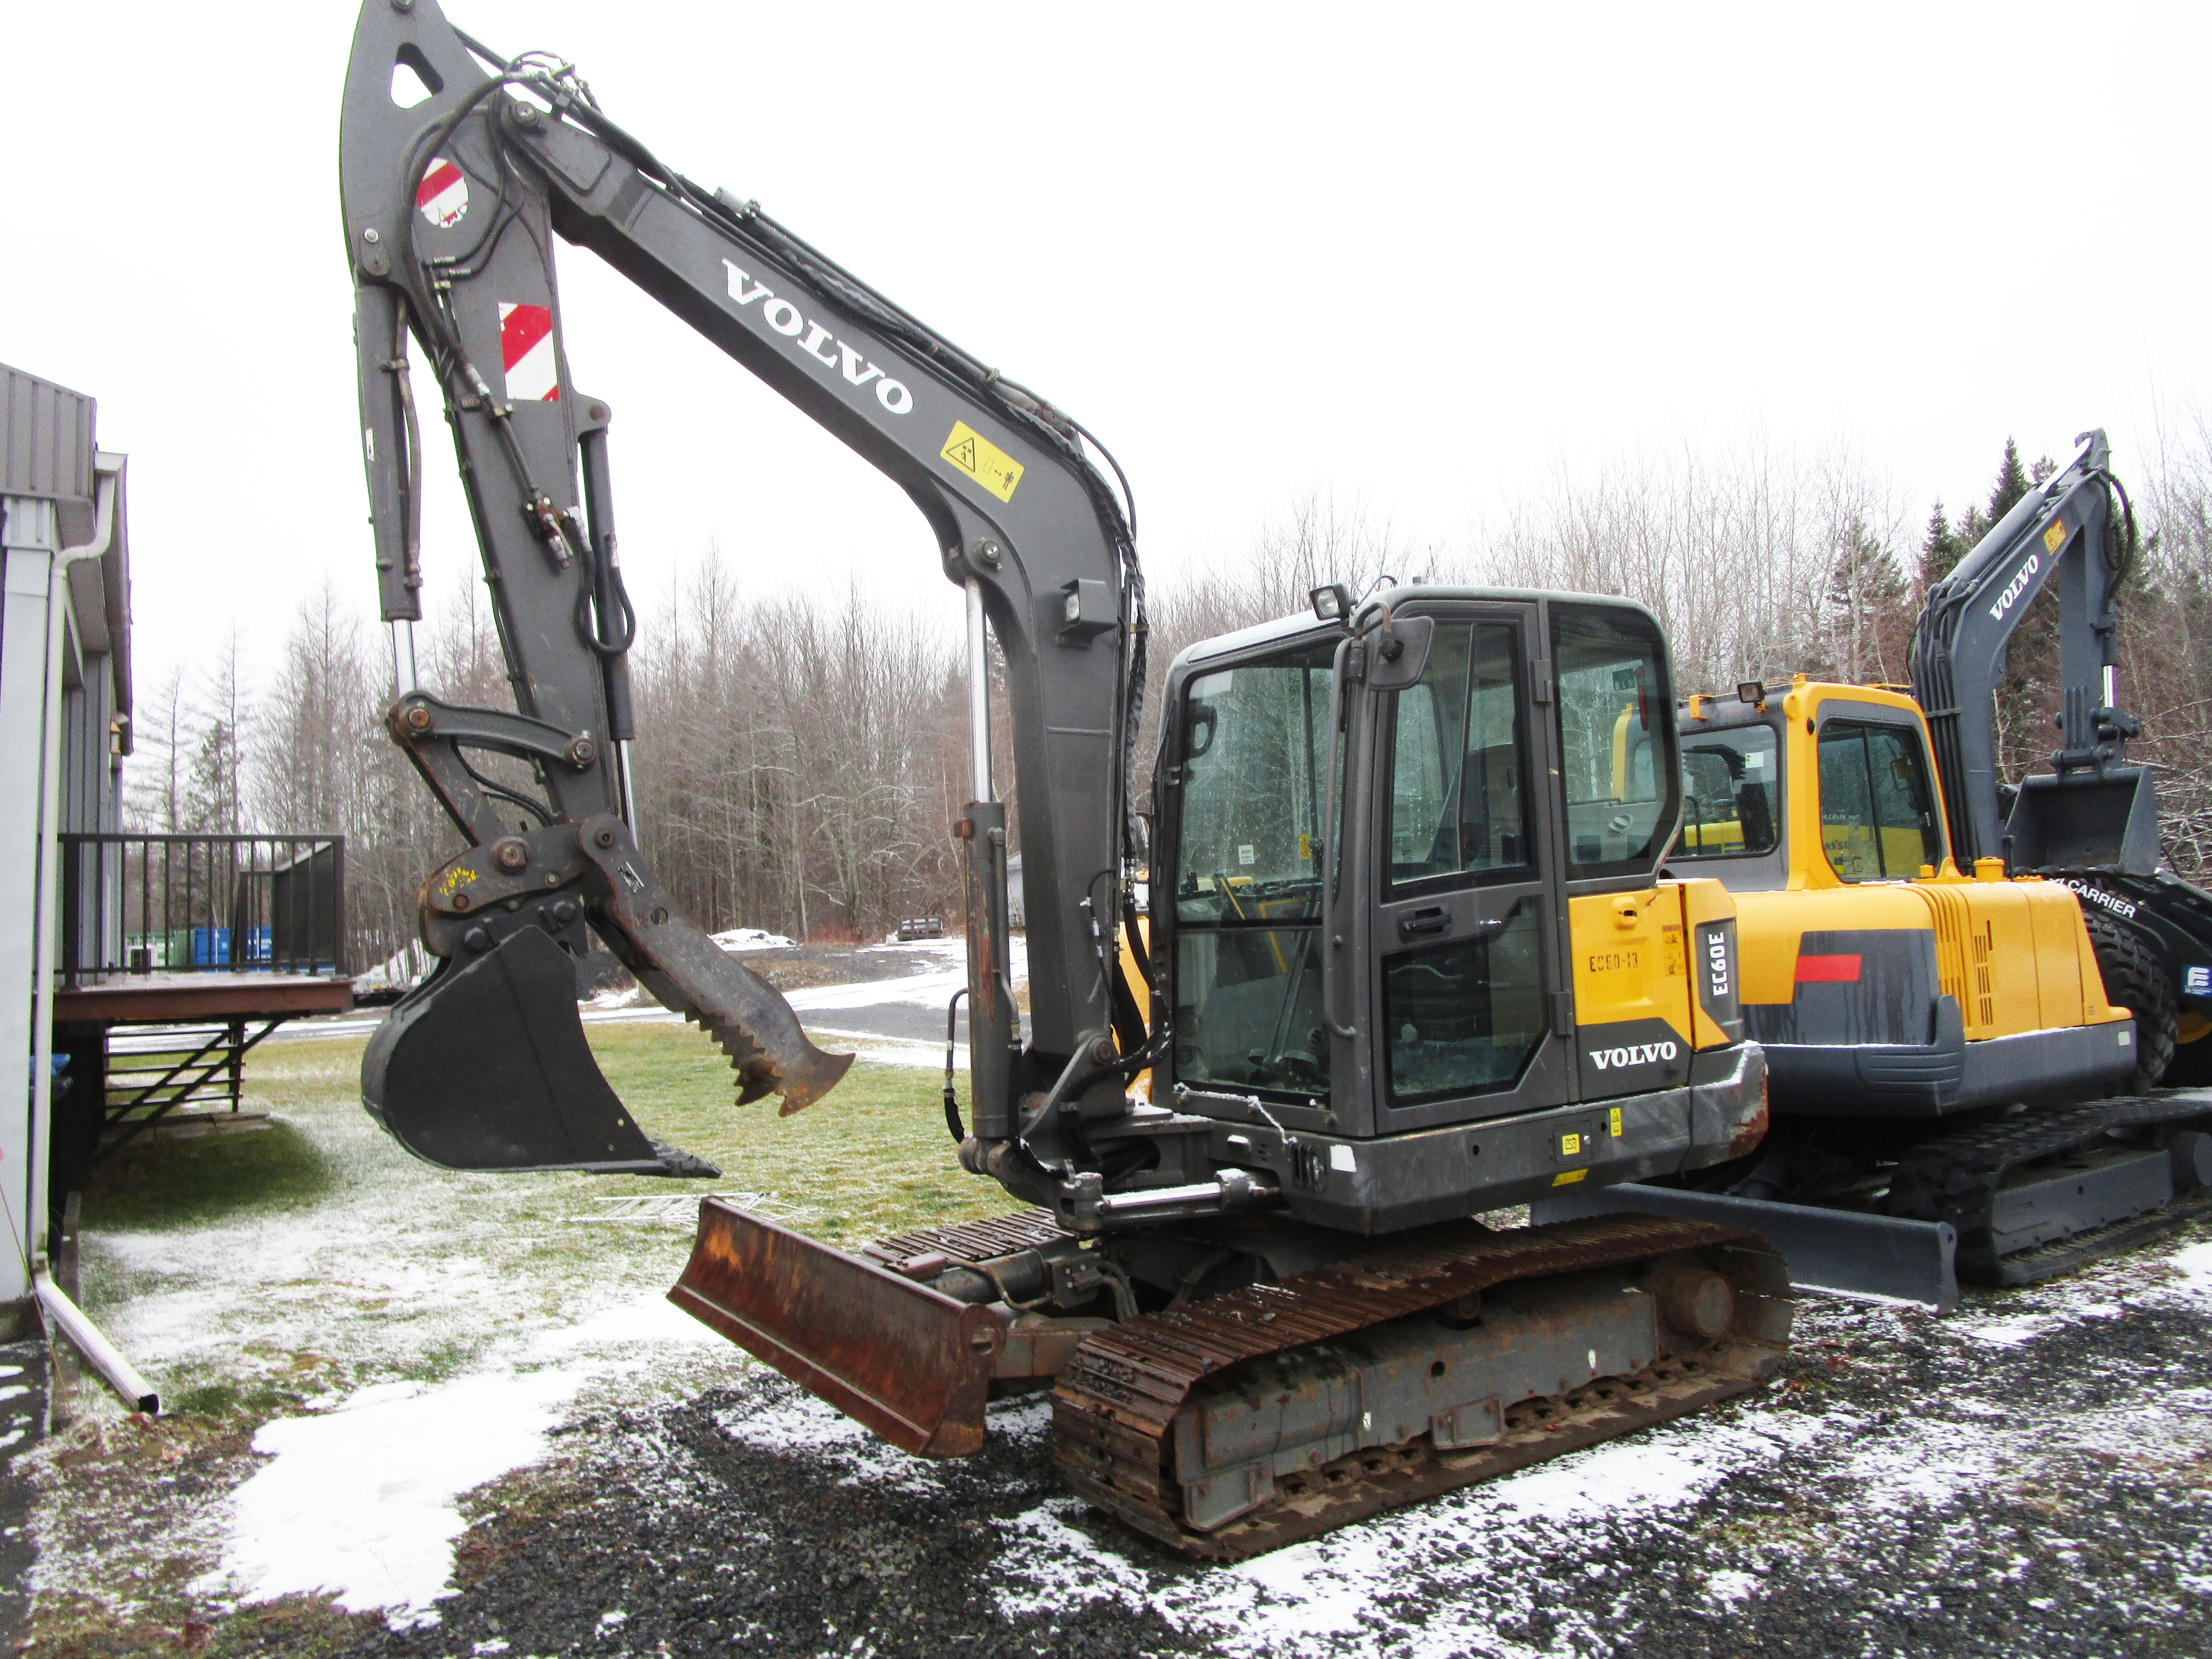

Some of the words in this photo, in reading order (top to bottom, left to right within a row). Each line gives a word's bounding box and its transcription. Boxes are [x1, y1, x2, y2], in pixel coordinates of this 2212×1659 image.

[721, 258, 913, 415] VOLVO
[1989, 554, 2039, 621] VOLVO
[2067, 880, 2136, 918] CARRIER
[1708, 932, 1729, 996] EC60E
[1589, 1041, 1677, 1070] VOLVO
